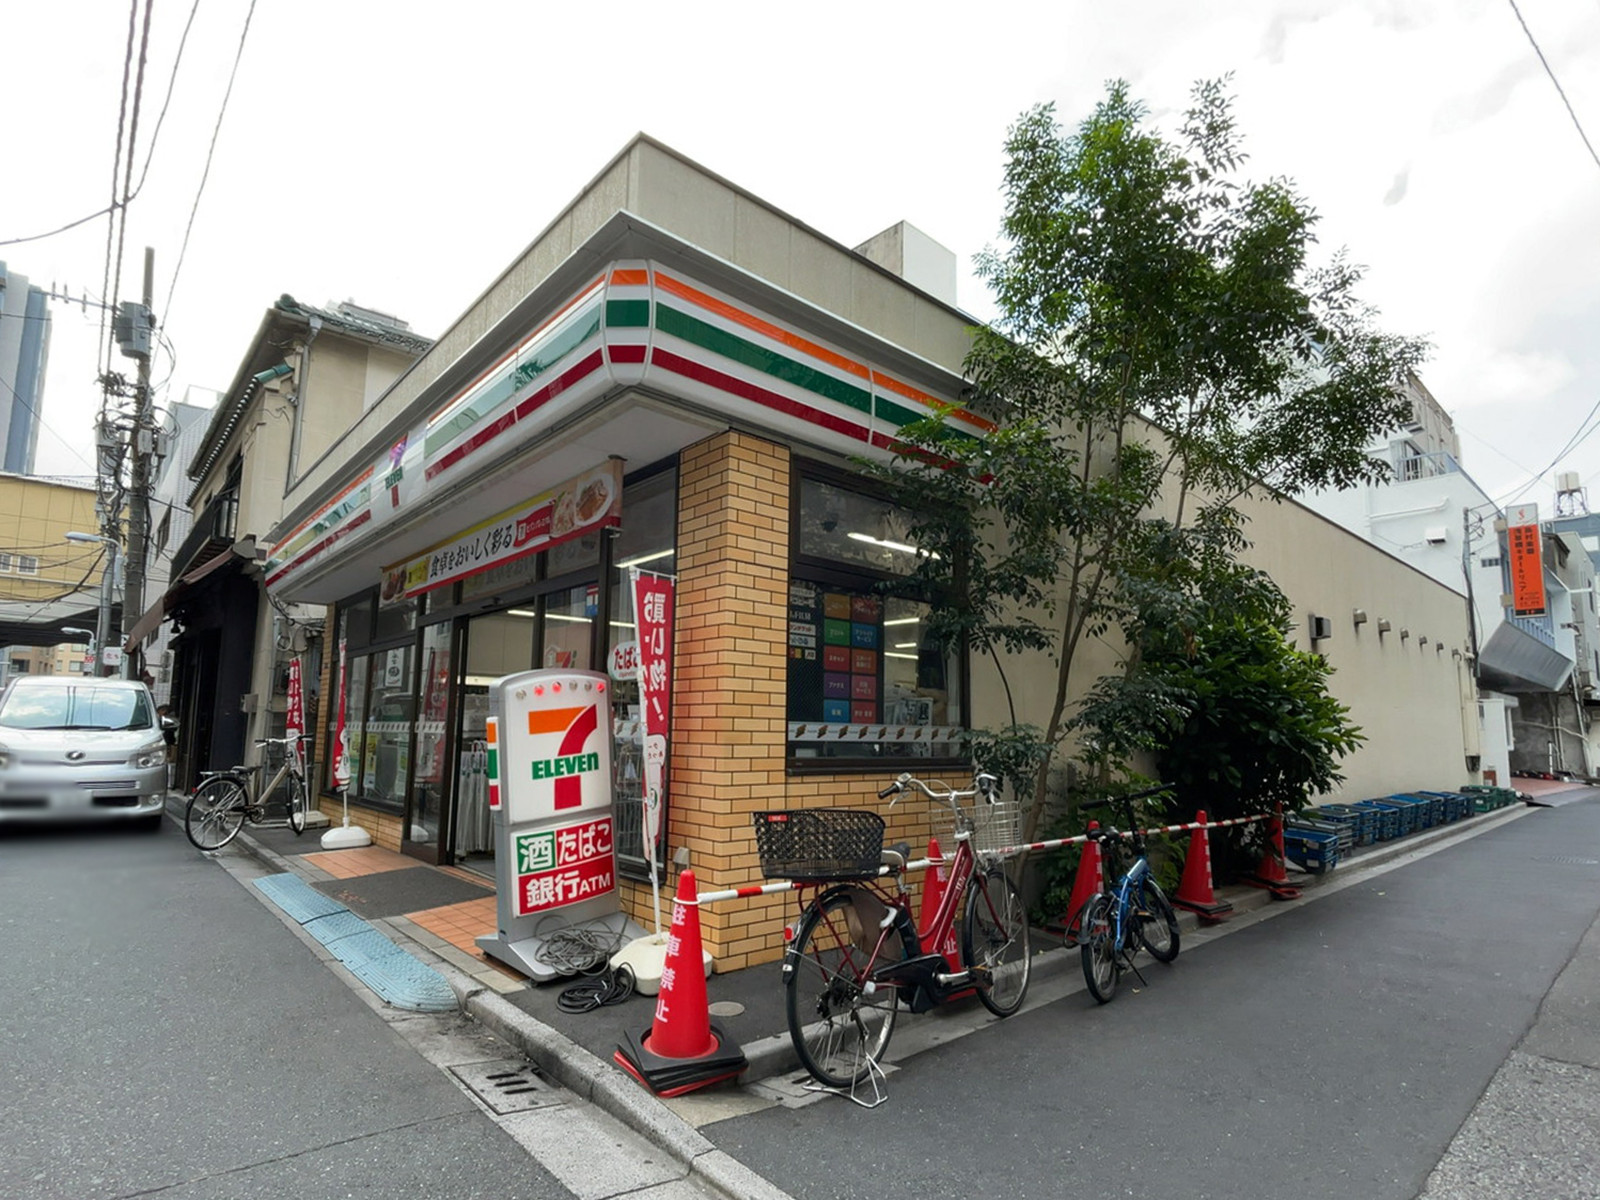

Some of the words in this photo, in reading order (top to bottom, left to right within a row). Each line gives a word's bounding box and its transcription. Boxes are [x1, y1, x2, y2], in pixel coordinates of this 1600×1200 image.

[430, 524, 514, 578] 食卓をおいしく彩る
[520, 834, 554, 872] 酒
[558, 823, 612, 865] たばこ
